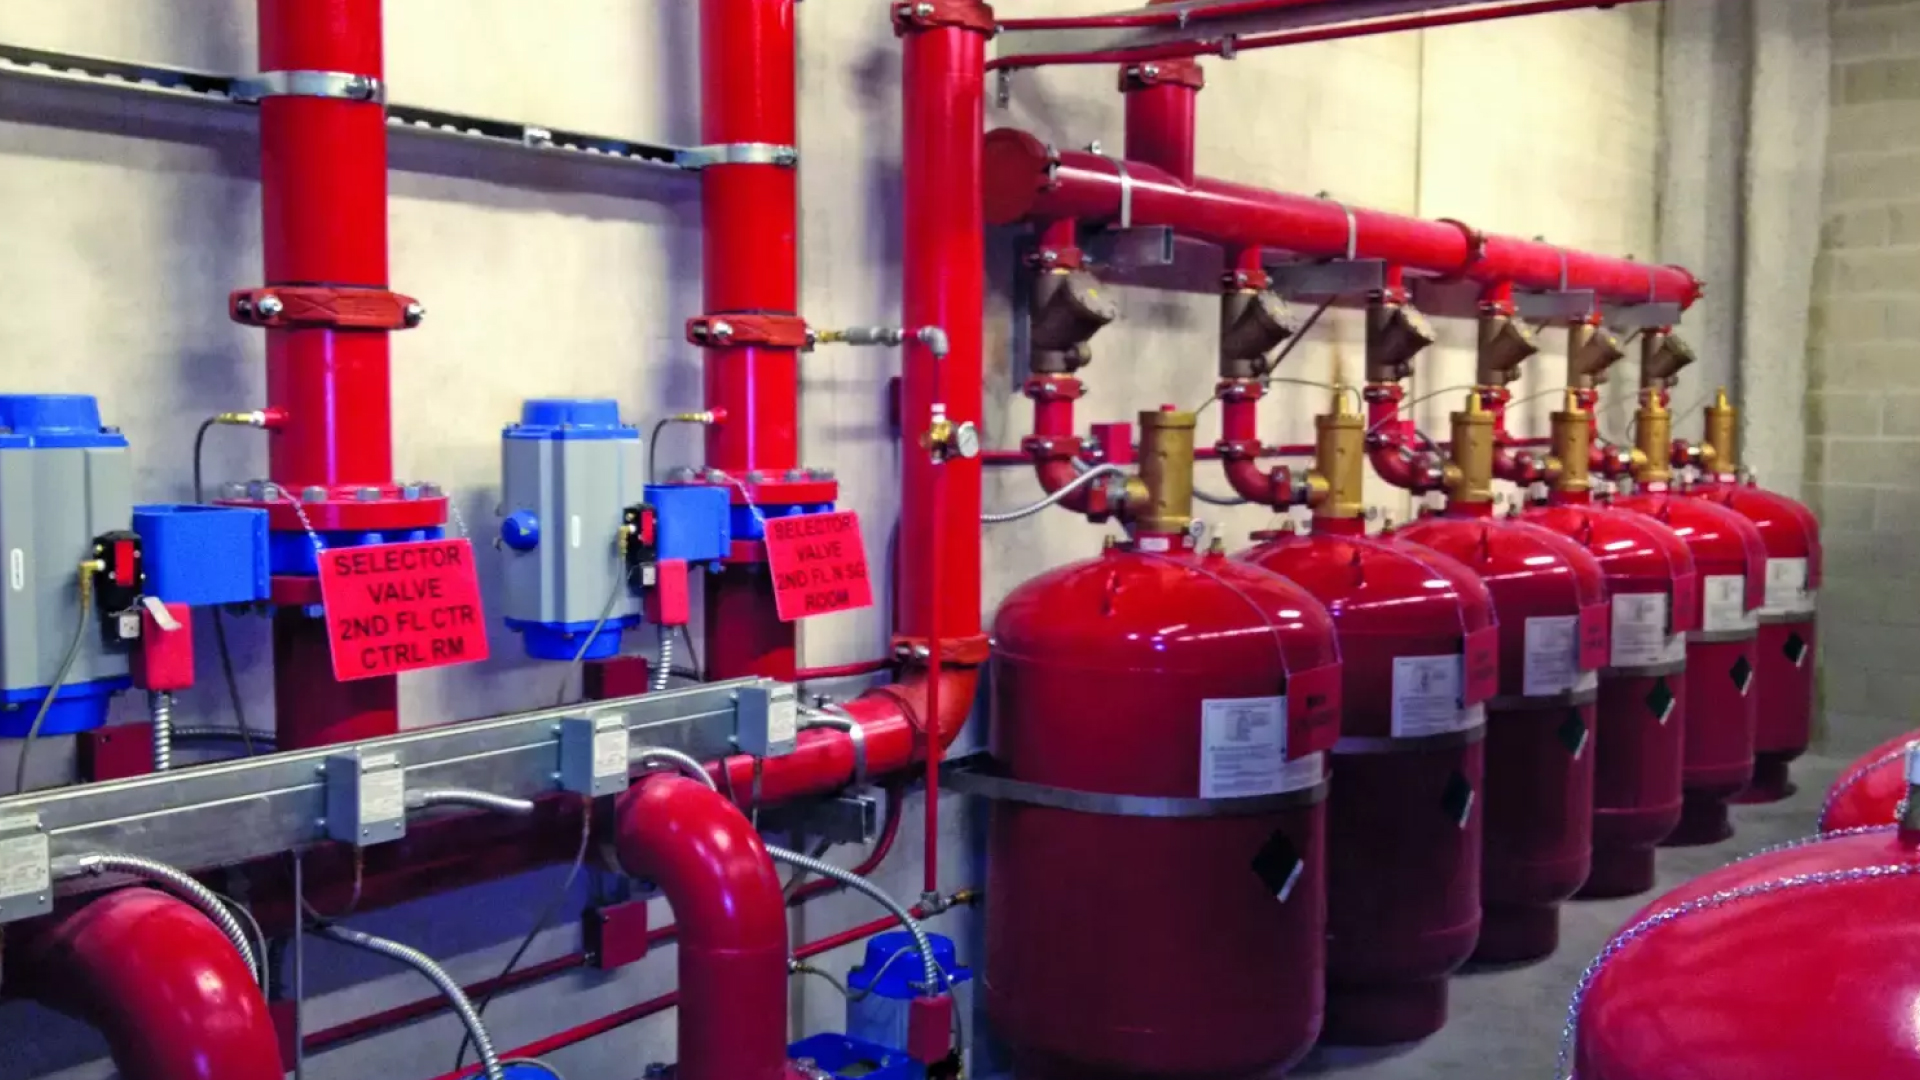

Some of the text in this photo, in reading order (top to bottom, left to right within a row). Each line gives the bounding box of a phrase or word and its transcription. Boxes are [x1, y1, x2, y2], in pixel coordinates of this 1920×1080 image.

[775, 515, 851, 540] SELECTOR
[334, 545, 461, 576] SELECTOR
[797, 541, 842, 562] VALVE
[367, 578, 442, 605] VALVE
[776, 569, 807, 591] 2ND
[812, 568, 830, 585] FL
[805, 589, 850, 611] ROOM
[340, 604, 475, 641] 2ND FL CTR
[361, 636, 464, 670] CTRL RM
